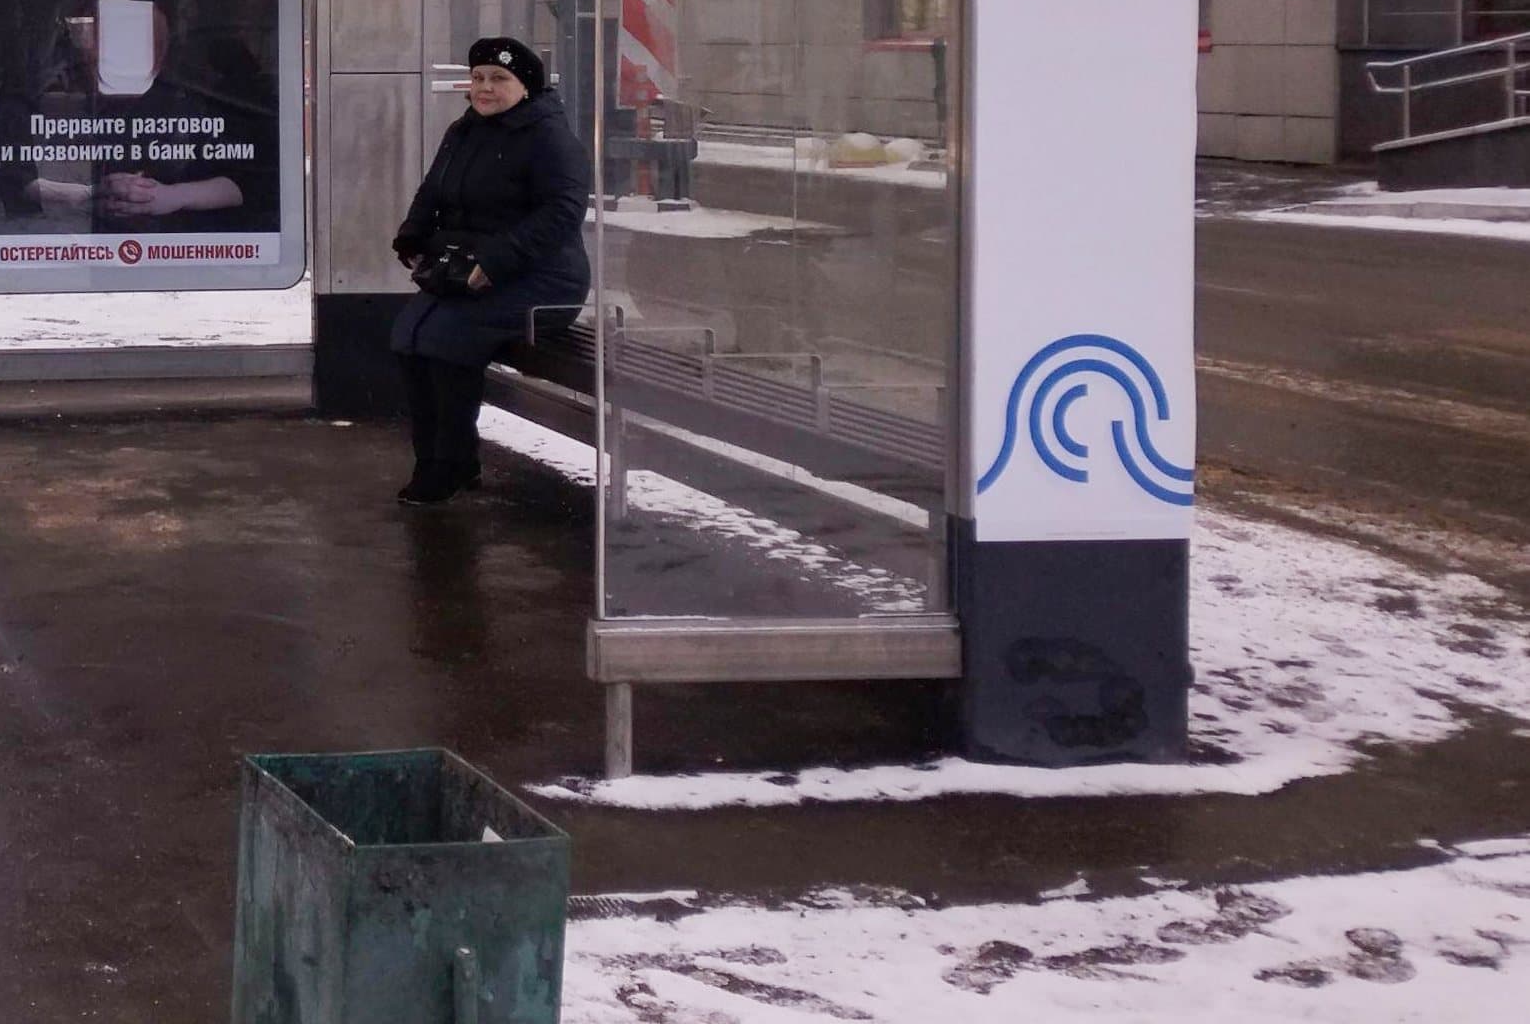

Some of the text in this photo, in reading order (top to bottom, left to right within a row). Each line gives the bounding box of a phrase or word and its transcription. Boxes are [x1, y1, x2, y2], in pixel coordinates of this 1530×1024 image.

[30, 114, 226, 139] Прервите разговор
[1, 140, 255, 162] и позвоните в банк сами
[0, 244, 260, 262] ОСТЕРЕГАЙТЕСЬ МОШЕННИКОВ!
